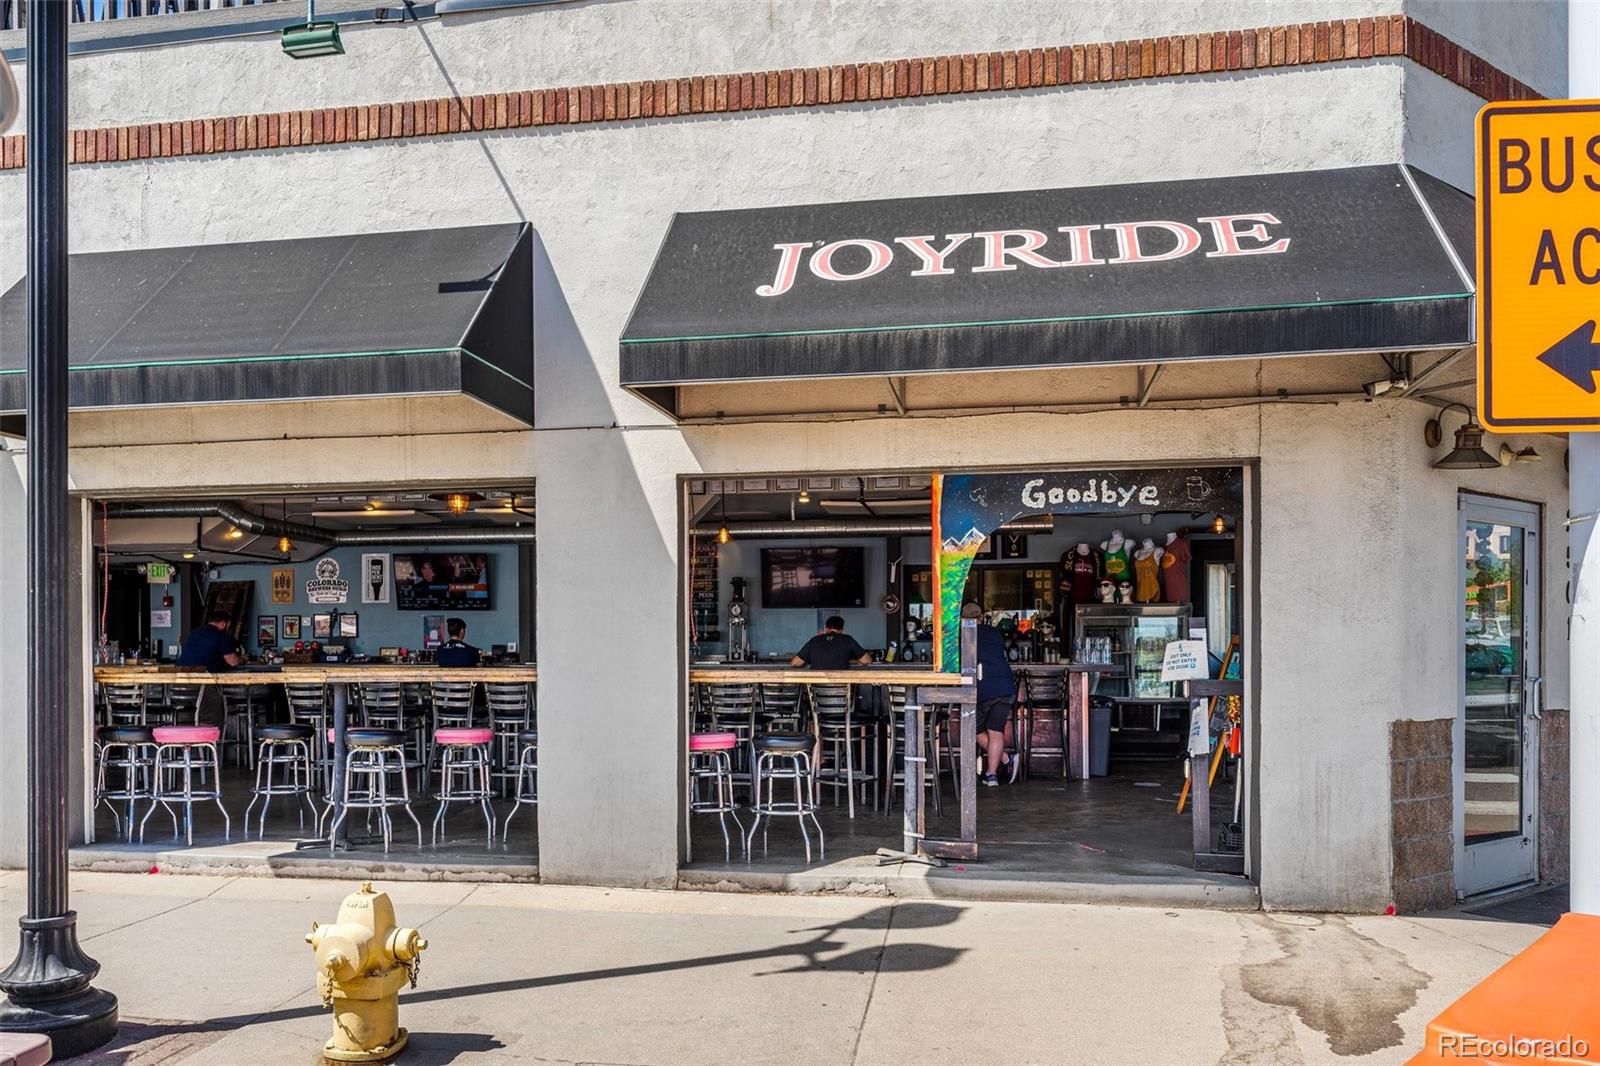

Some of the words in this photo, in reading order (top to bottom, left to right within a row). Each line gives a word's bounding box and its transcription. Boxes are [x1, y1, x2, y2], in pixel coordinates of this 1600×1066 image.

[755, 212, 1292, 297] JOYRIDE
[1529, 226, 1600, 286] AC
[1021, 478, 1161, 510] Goodbye
[151, 565, 166, 577] EXIT
[307, 579, 348, 588] COLORADO
